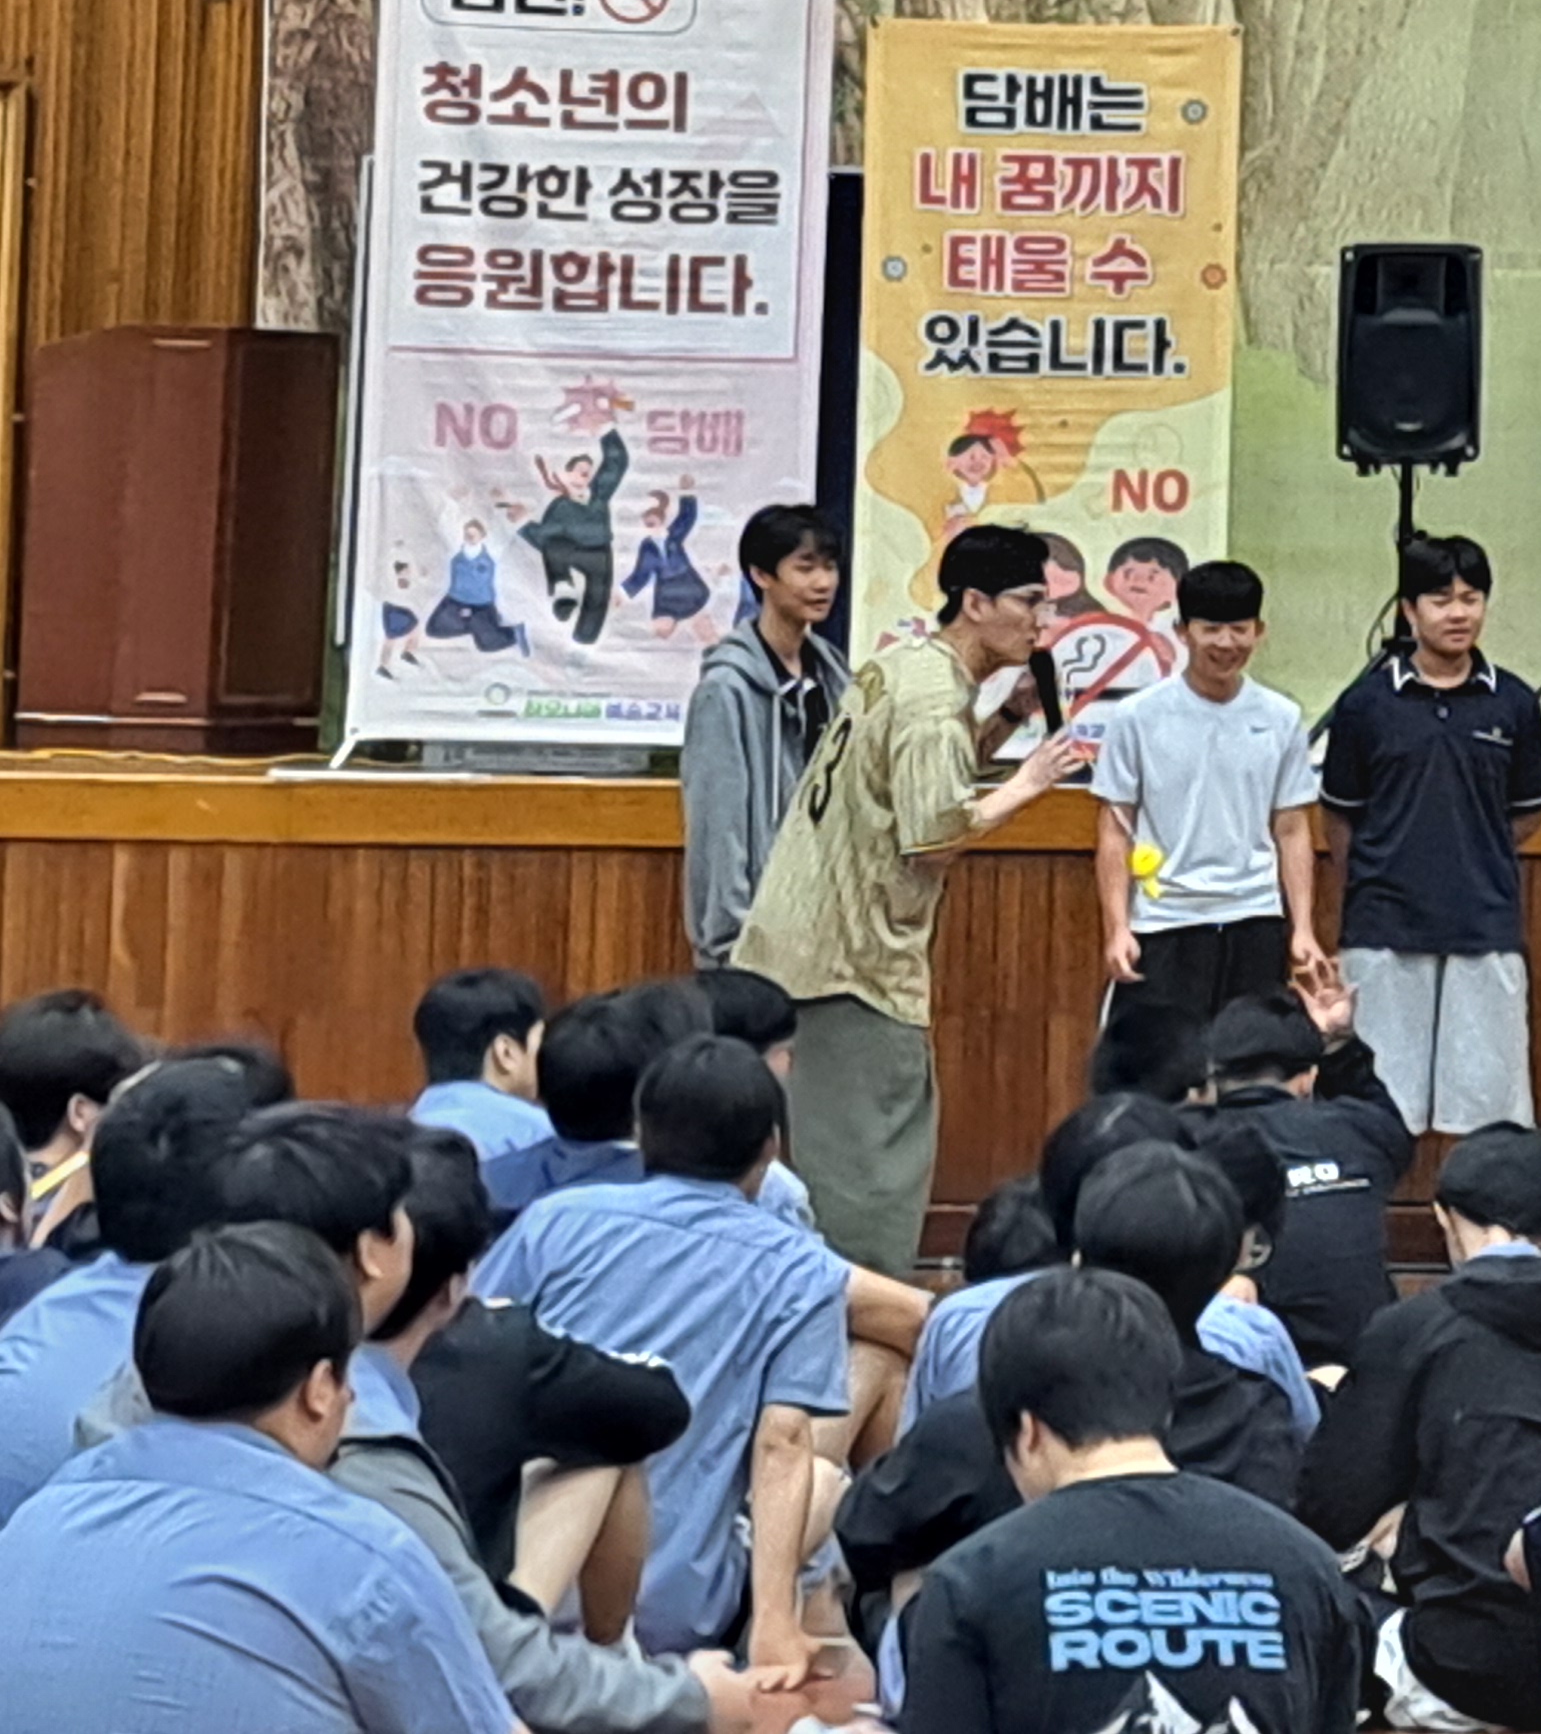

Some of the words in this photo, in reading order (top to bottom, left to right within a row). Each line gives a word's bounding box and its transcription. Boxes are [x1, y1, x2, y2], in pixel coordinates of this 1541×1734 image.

[420, 61, 689, 133] 청소년의
[963, 72, 1145, 132] 담배는
[417, 159, 593, 221] 건강한
[607, 167, 782, 226] 성장을
[918, 151, 978, 210] 내
[999, 154, 1182, 214] 꿈까지
[412, 243, 769, 316] 응원합니다.
[947, 233, 1067, 293] 태울
[1089, 237, 1149, 296] 수
[923, 314, 1187, 376] 있습니다.
[434, 401, 519, 450] NO
[645, 408, 746, 457] 담배
[1111, 468, 1191, 513] NO
[1044, 1588, 1281, 1627] SCENIC
[1048, 1627, 1288, 1673] ROUTE
